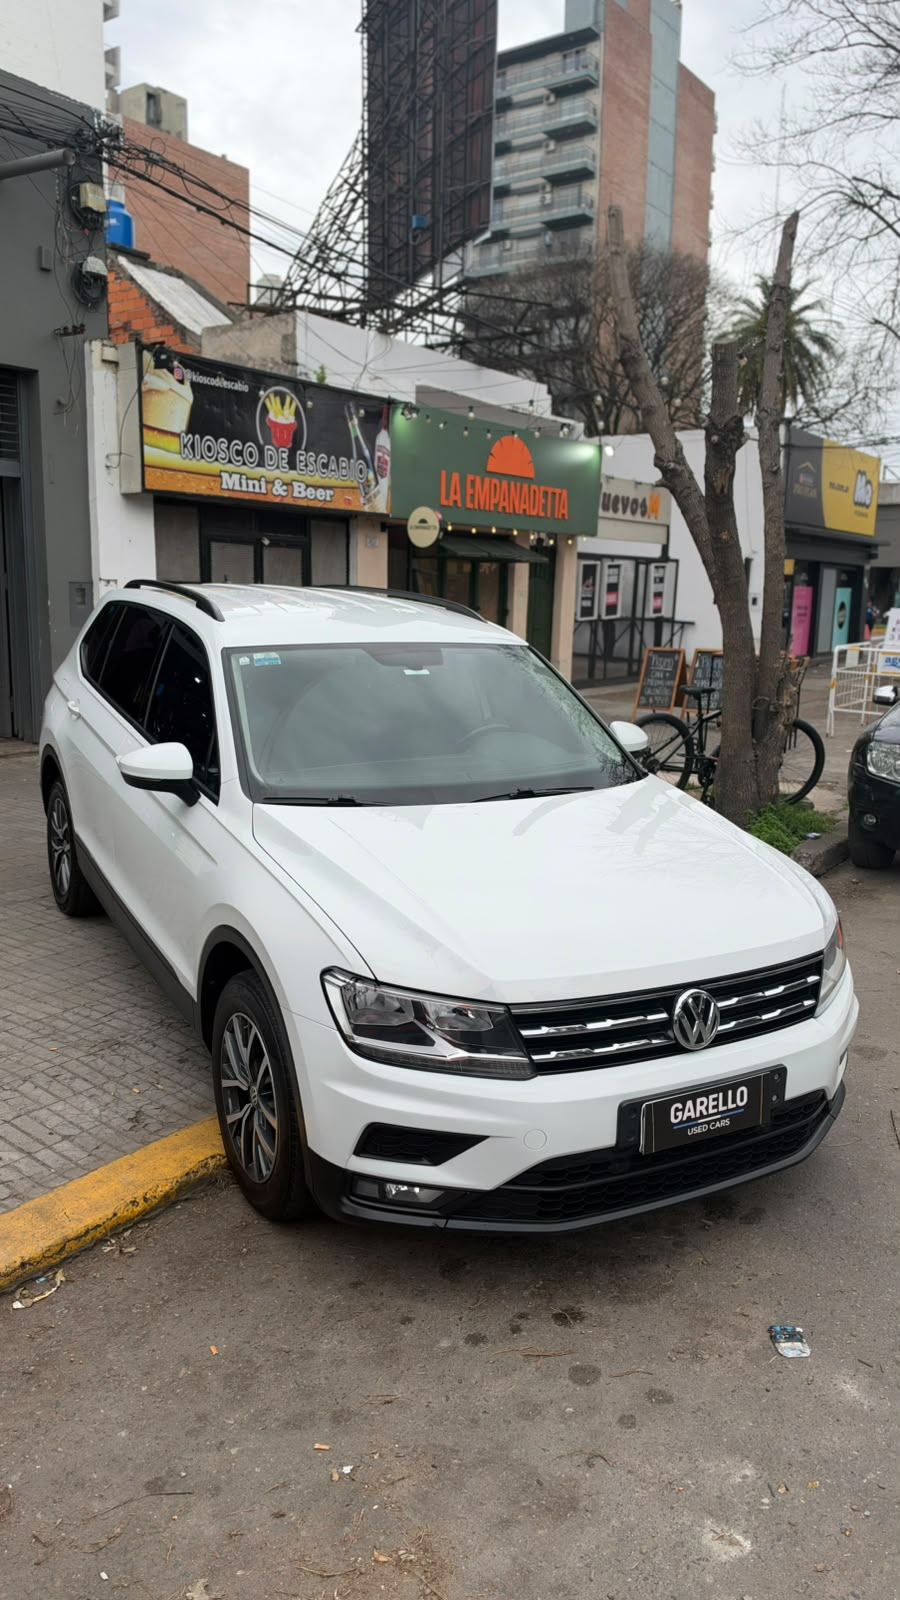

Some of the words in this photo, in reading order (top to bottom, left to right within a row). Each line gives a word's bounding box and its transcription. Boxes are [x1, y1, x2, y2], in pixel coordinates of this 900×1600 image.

[180, 433, 259, 469] KIOSCO
[265, 445, 289, 472] DE
[296, 450, 367, 483] ESCABIO
[220, 471, 268, 494] Mini
[272, 478, 288, 497] &
[292, 481, 334, 501] Beer
[440, 470, 461, 508] LA
[465, 474, 568, 519] EMPANADETTA
[670, 1086, 748, 1124] GARELLO
[687, 1123, 709, 1136] USED
[710, 1119, 730, 1131] CARS
